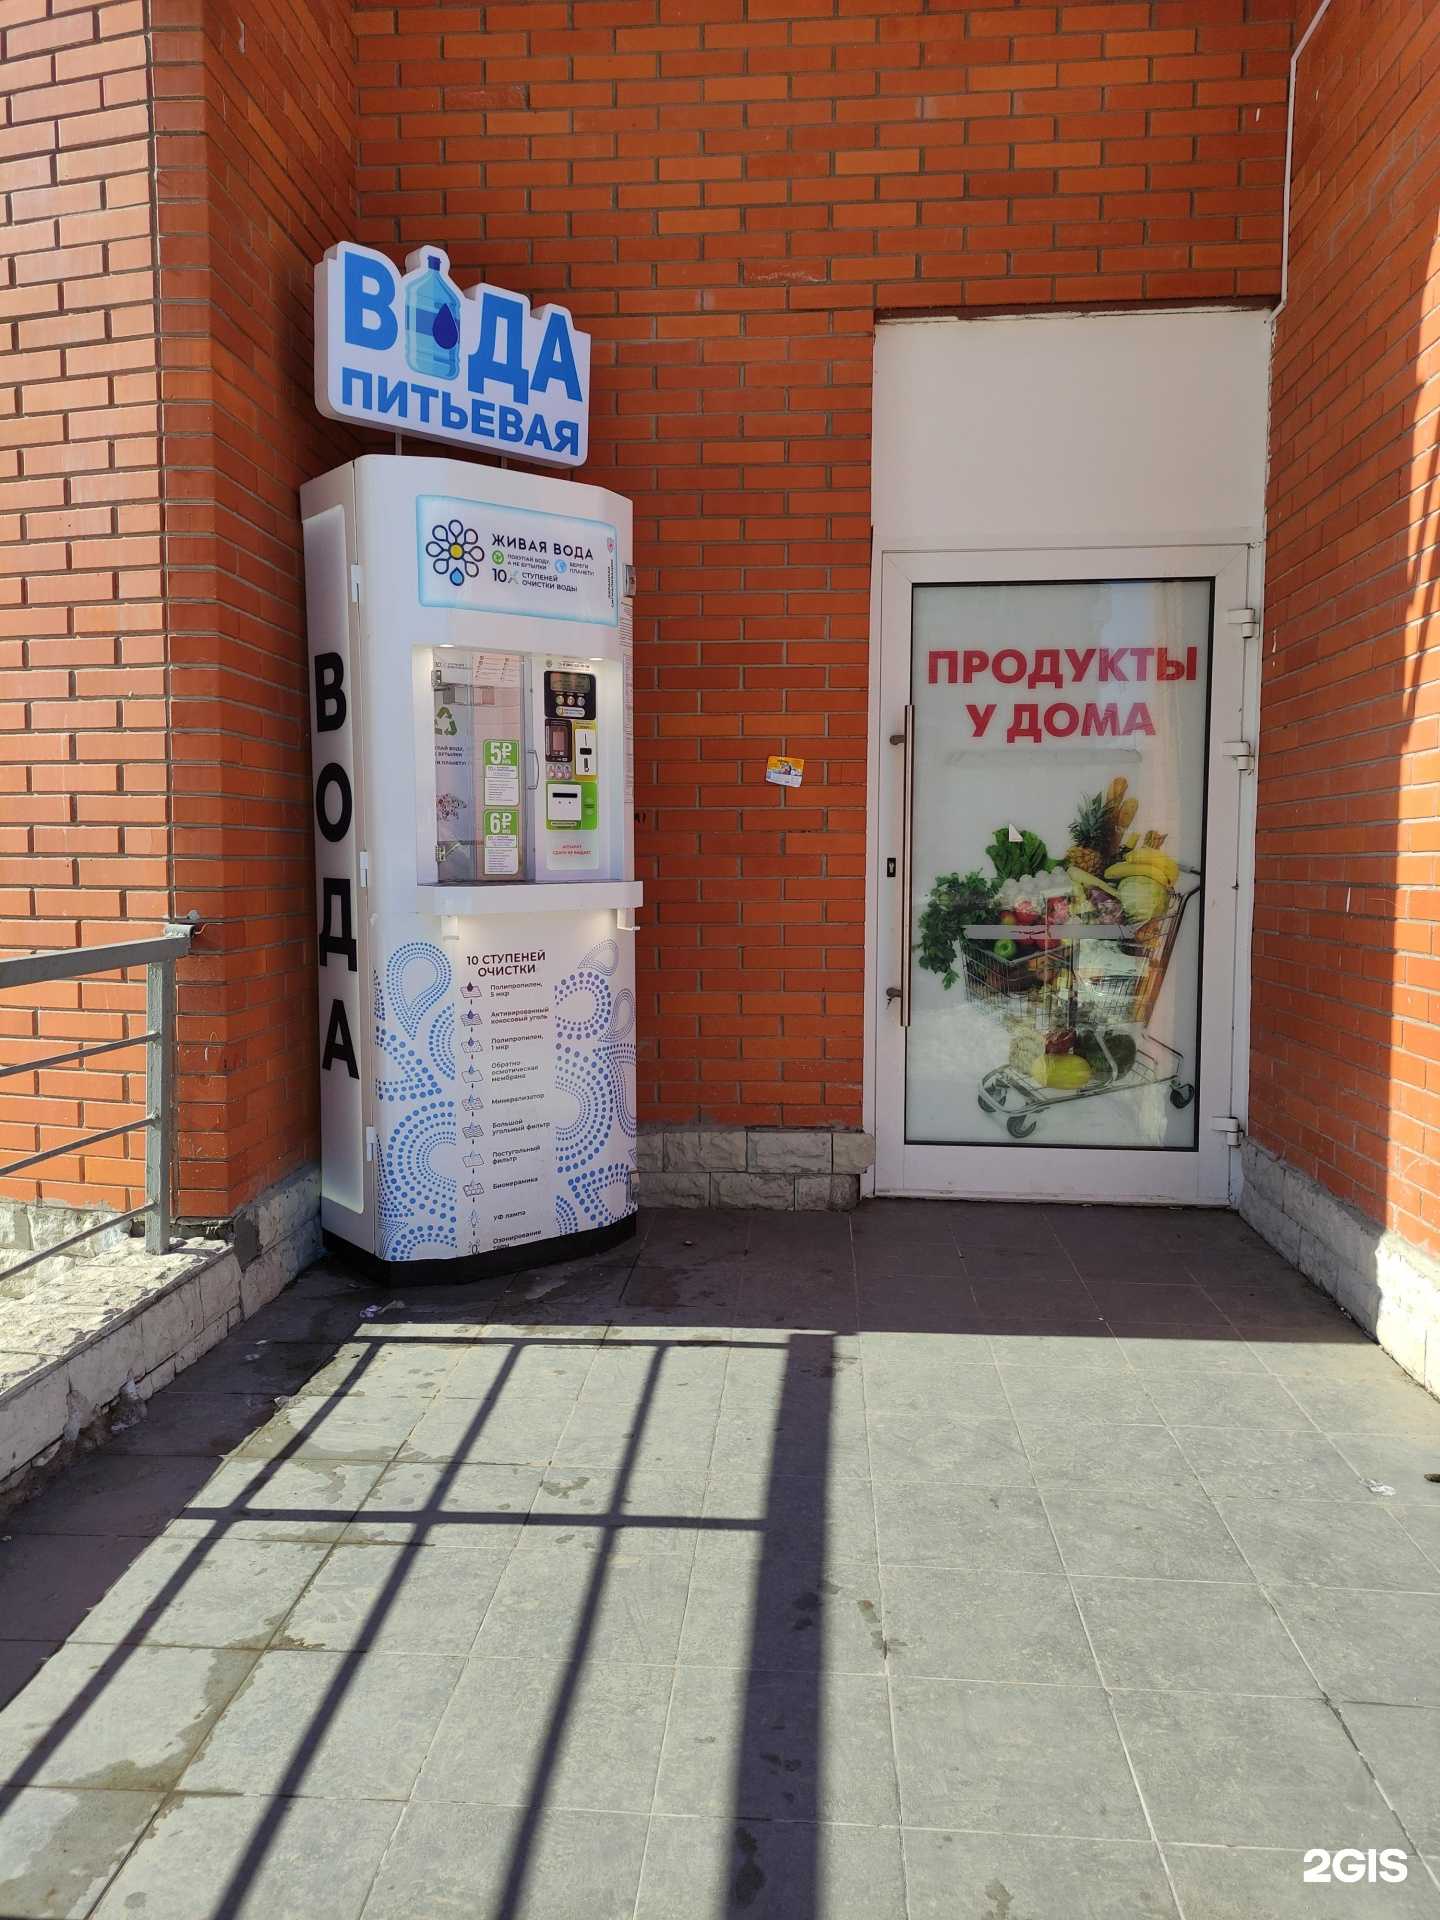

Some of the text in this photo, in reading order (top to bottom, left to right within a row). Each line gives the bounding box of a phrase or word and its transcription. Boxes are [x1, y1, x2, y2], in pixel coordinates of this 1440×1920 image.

[342, 366, 580, 457] ПИТЬЕВАЯ
[491, 533, 594, 561] ЖИВАЯ ВОДА
[491, 568, 507, 583] 10
[521, 572, 559, 582] СТУПЕНЕЙ
[521, 580, 577, 592] ОЧИСТКИ ВОДЫ
[928, 646, 1198, 689] ПРОДУКТЫ
[965, 702, 1157, 743] У ДОМА
[314, 652, 360, 1080] ВОДА
[466, 949, 546, 966] 10 СТУПЕНЕЙ
[478, 964, 536, 977] ОЧИСТКИ
[490, 982, 543, 990] Полипропилен,
[490, 1006, 549, 1017] Активированный
[490, 1016, 528, 1024] кокосовый
[491, 1034, 544, 1044] Полипропилен,
[491, 1065, 539, 1075] осмотическая
[491, 1074, 526, 1082] мембрана
[491, 1093, 545, 1105] Минерализатор
[492, 1118, 523, 1129] Большой
[492, 1122, 551, 1136] угольный фильтр
[492, 1145, 541, 1158] Постугольный
[492, 1156, 518, 1165] фильтр
[492, 1177, 538, 1190] Биокерамика
[505, 1210, 526, 1219] лампа
[492, 1230, 542, 1245] Озонирование
